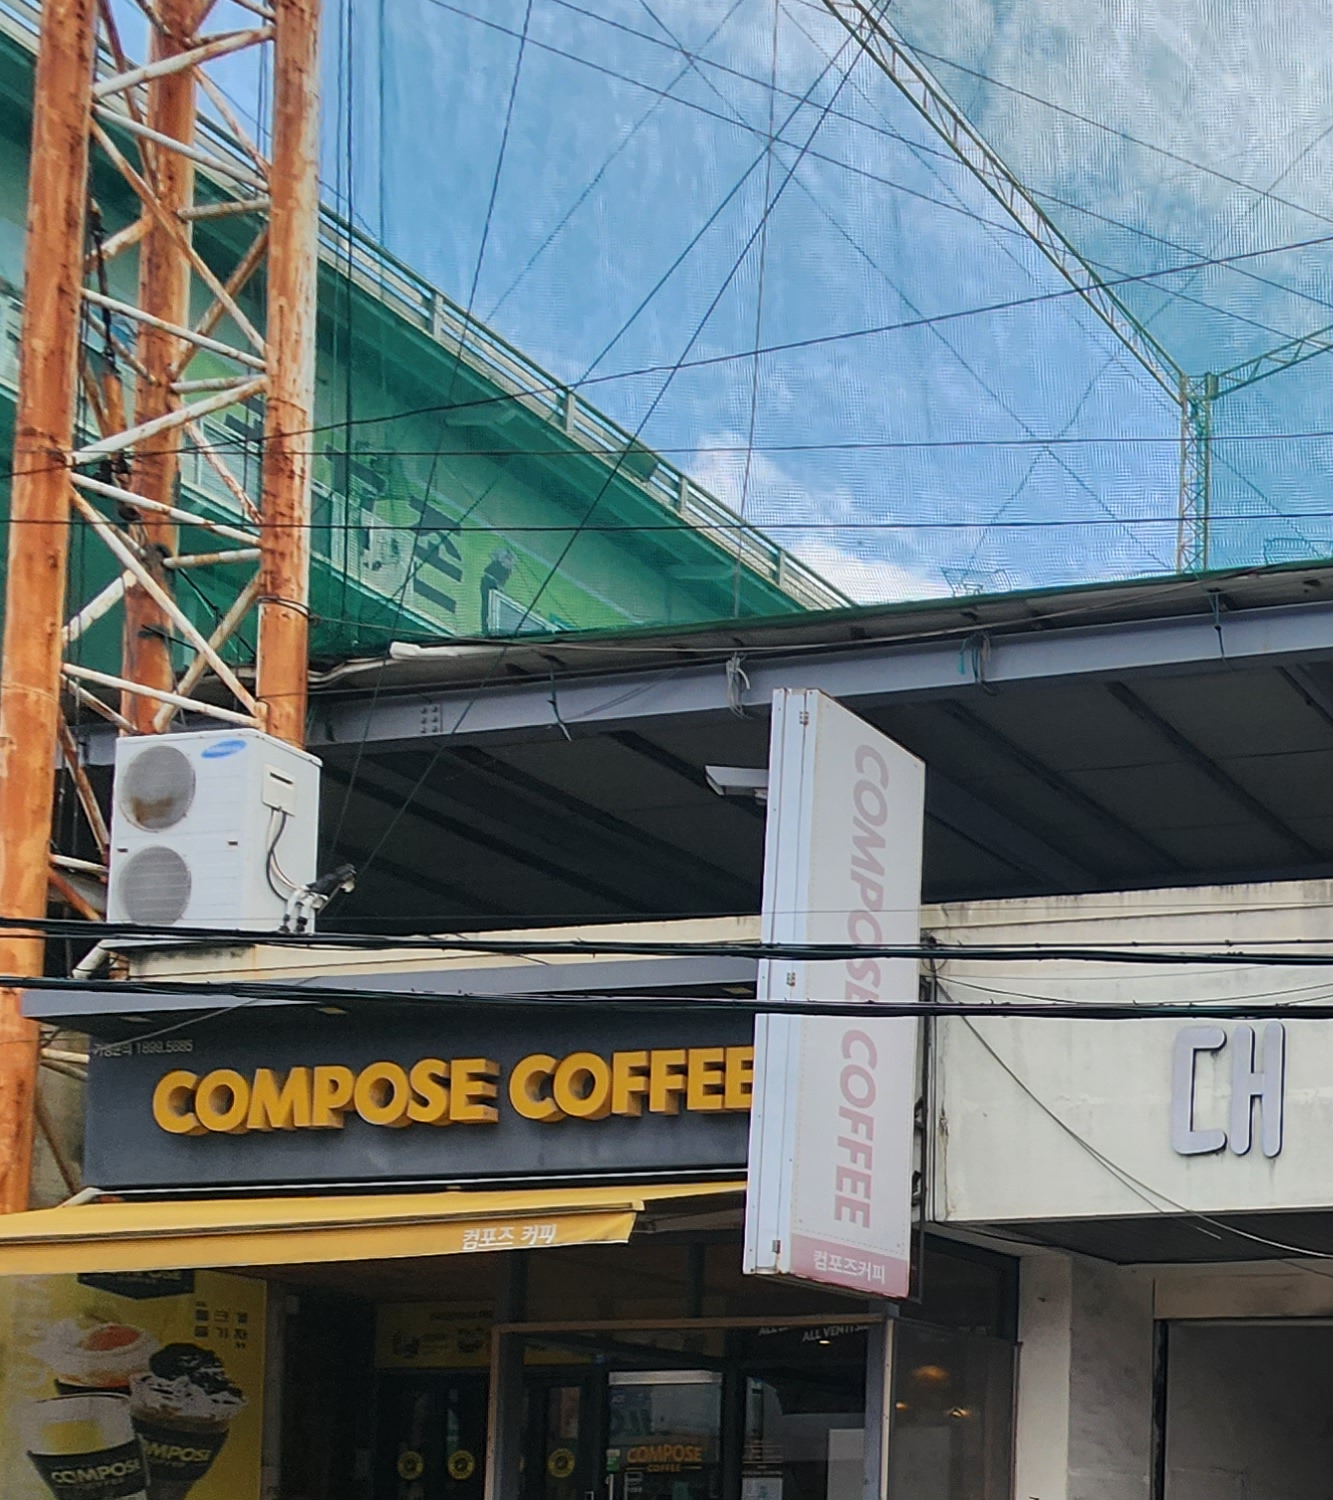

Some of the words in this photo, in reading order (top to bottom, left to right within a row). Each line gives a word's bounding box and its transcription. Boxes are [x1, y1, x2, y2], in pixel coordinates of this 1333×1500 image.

[153, 1057, 498, 1137] COMPOSE
[509, 1046, 754, 1123] COFFEE
[833, 1028, 879, 1229] COFFEE
[462, 1226, 514, 1251] 컴포즈
[519, 1223, 558, 1244] 커피
[812, 1247, 887, 1286] 컴포즈커피
[627, 1444, 702, 1463] COMPOSE
